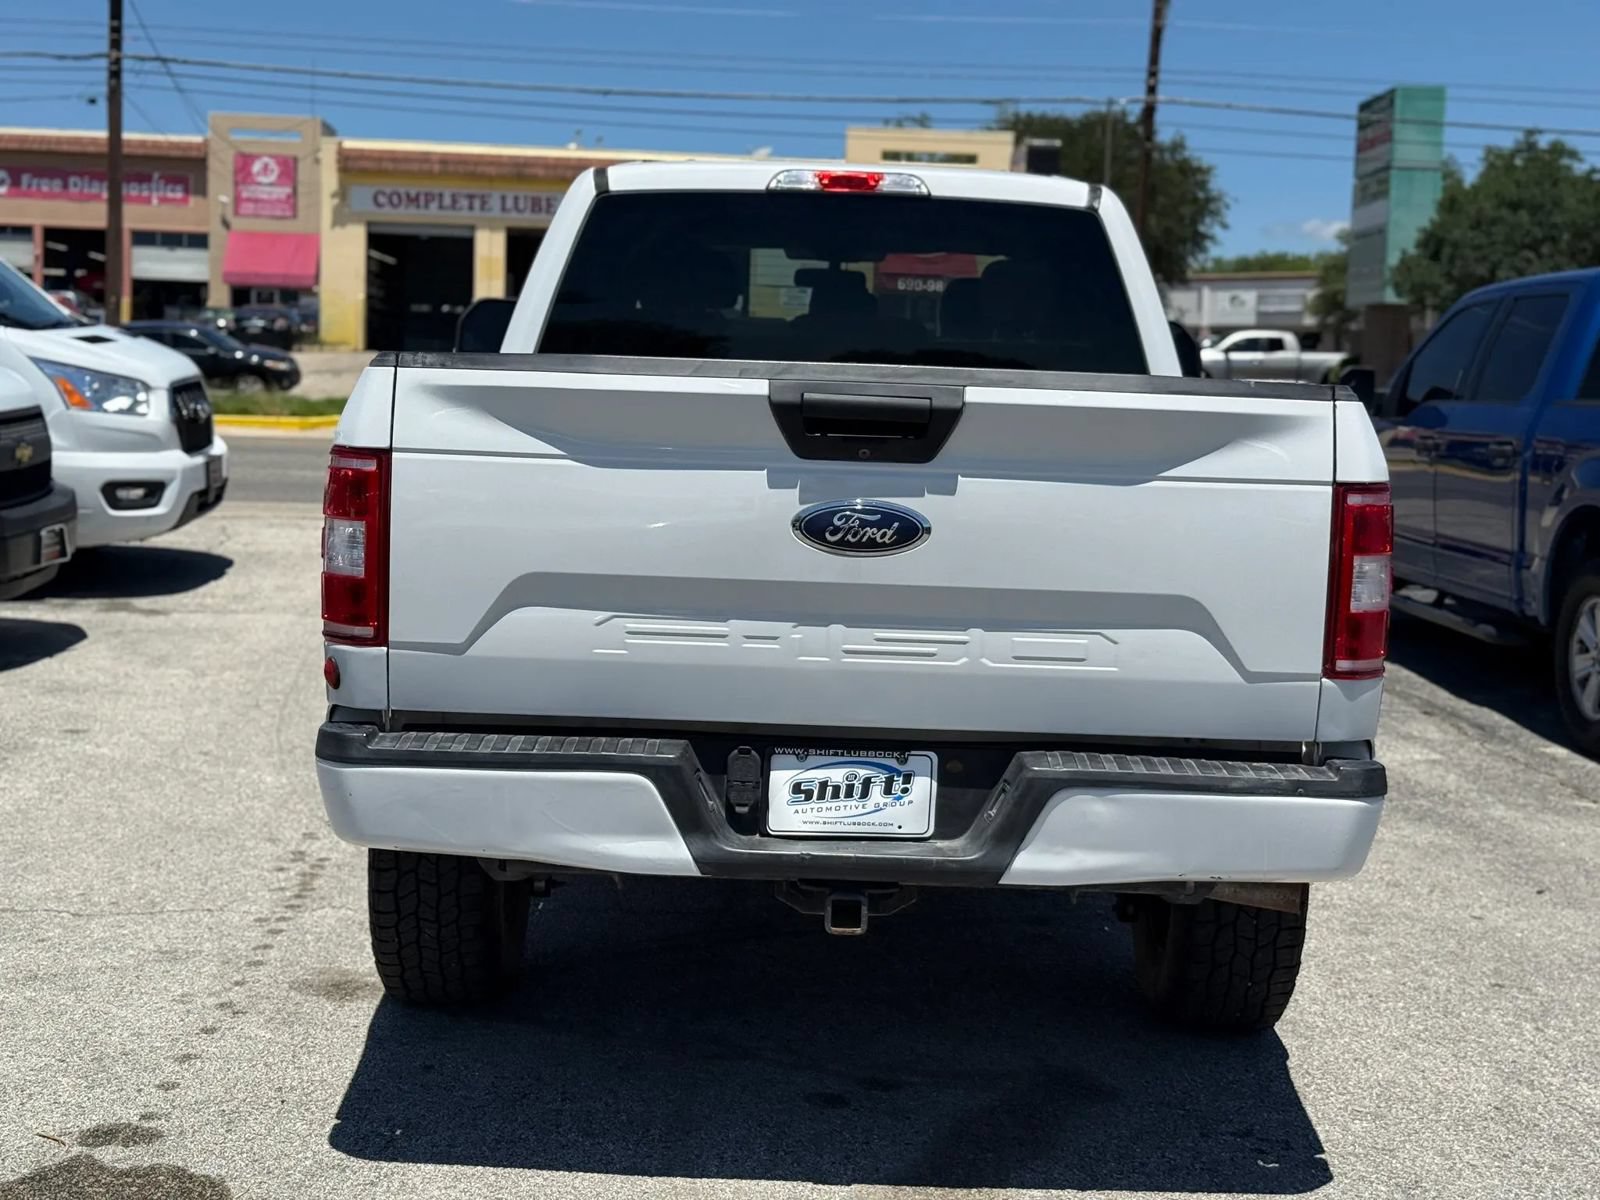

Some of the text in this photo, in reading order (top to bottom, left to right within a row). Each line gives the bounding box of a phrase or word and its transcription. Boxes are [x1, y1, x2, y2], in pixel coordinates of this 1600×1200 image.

[21, 173, 63, 192] Free
[372, 189, 557, 216] COMPLETE LUBE
[825, 511, 899, 544] Ford
[593, 612, 1119, 672] F-150
[788, 771, 914, 804] Shift!
[793, 800, 914, 814] AUTOMOTIVE GROUP
